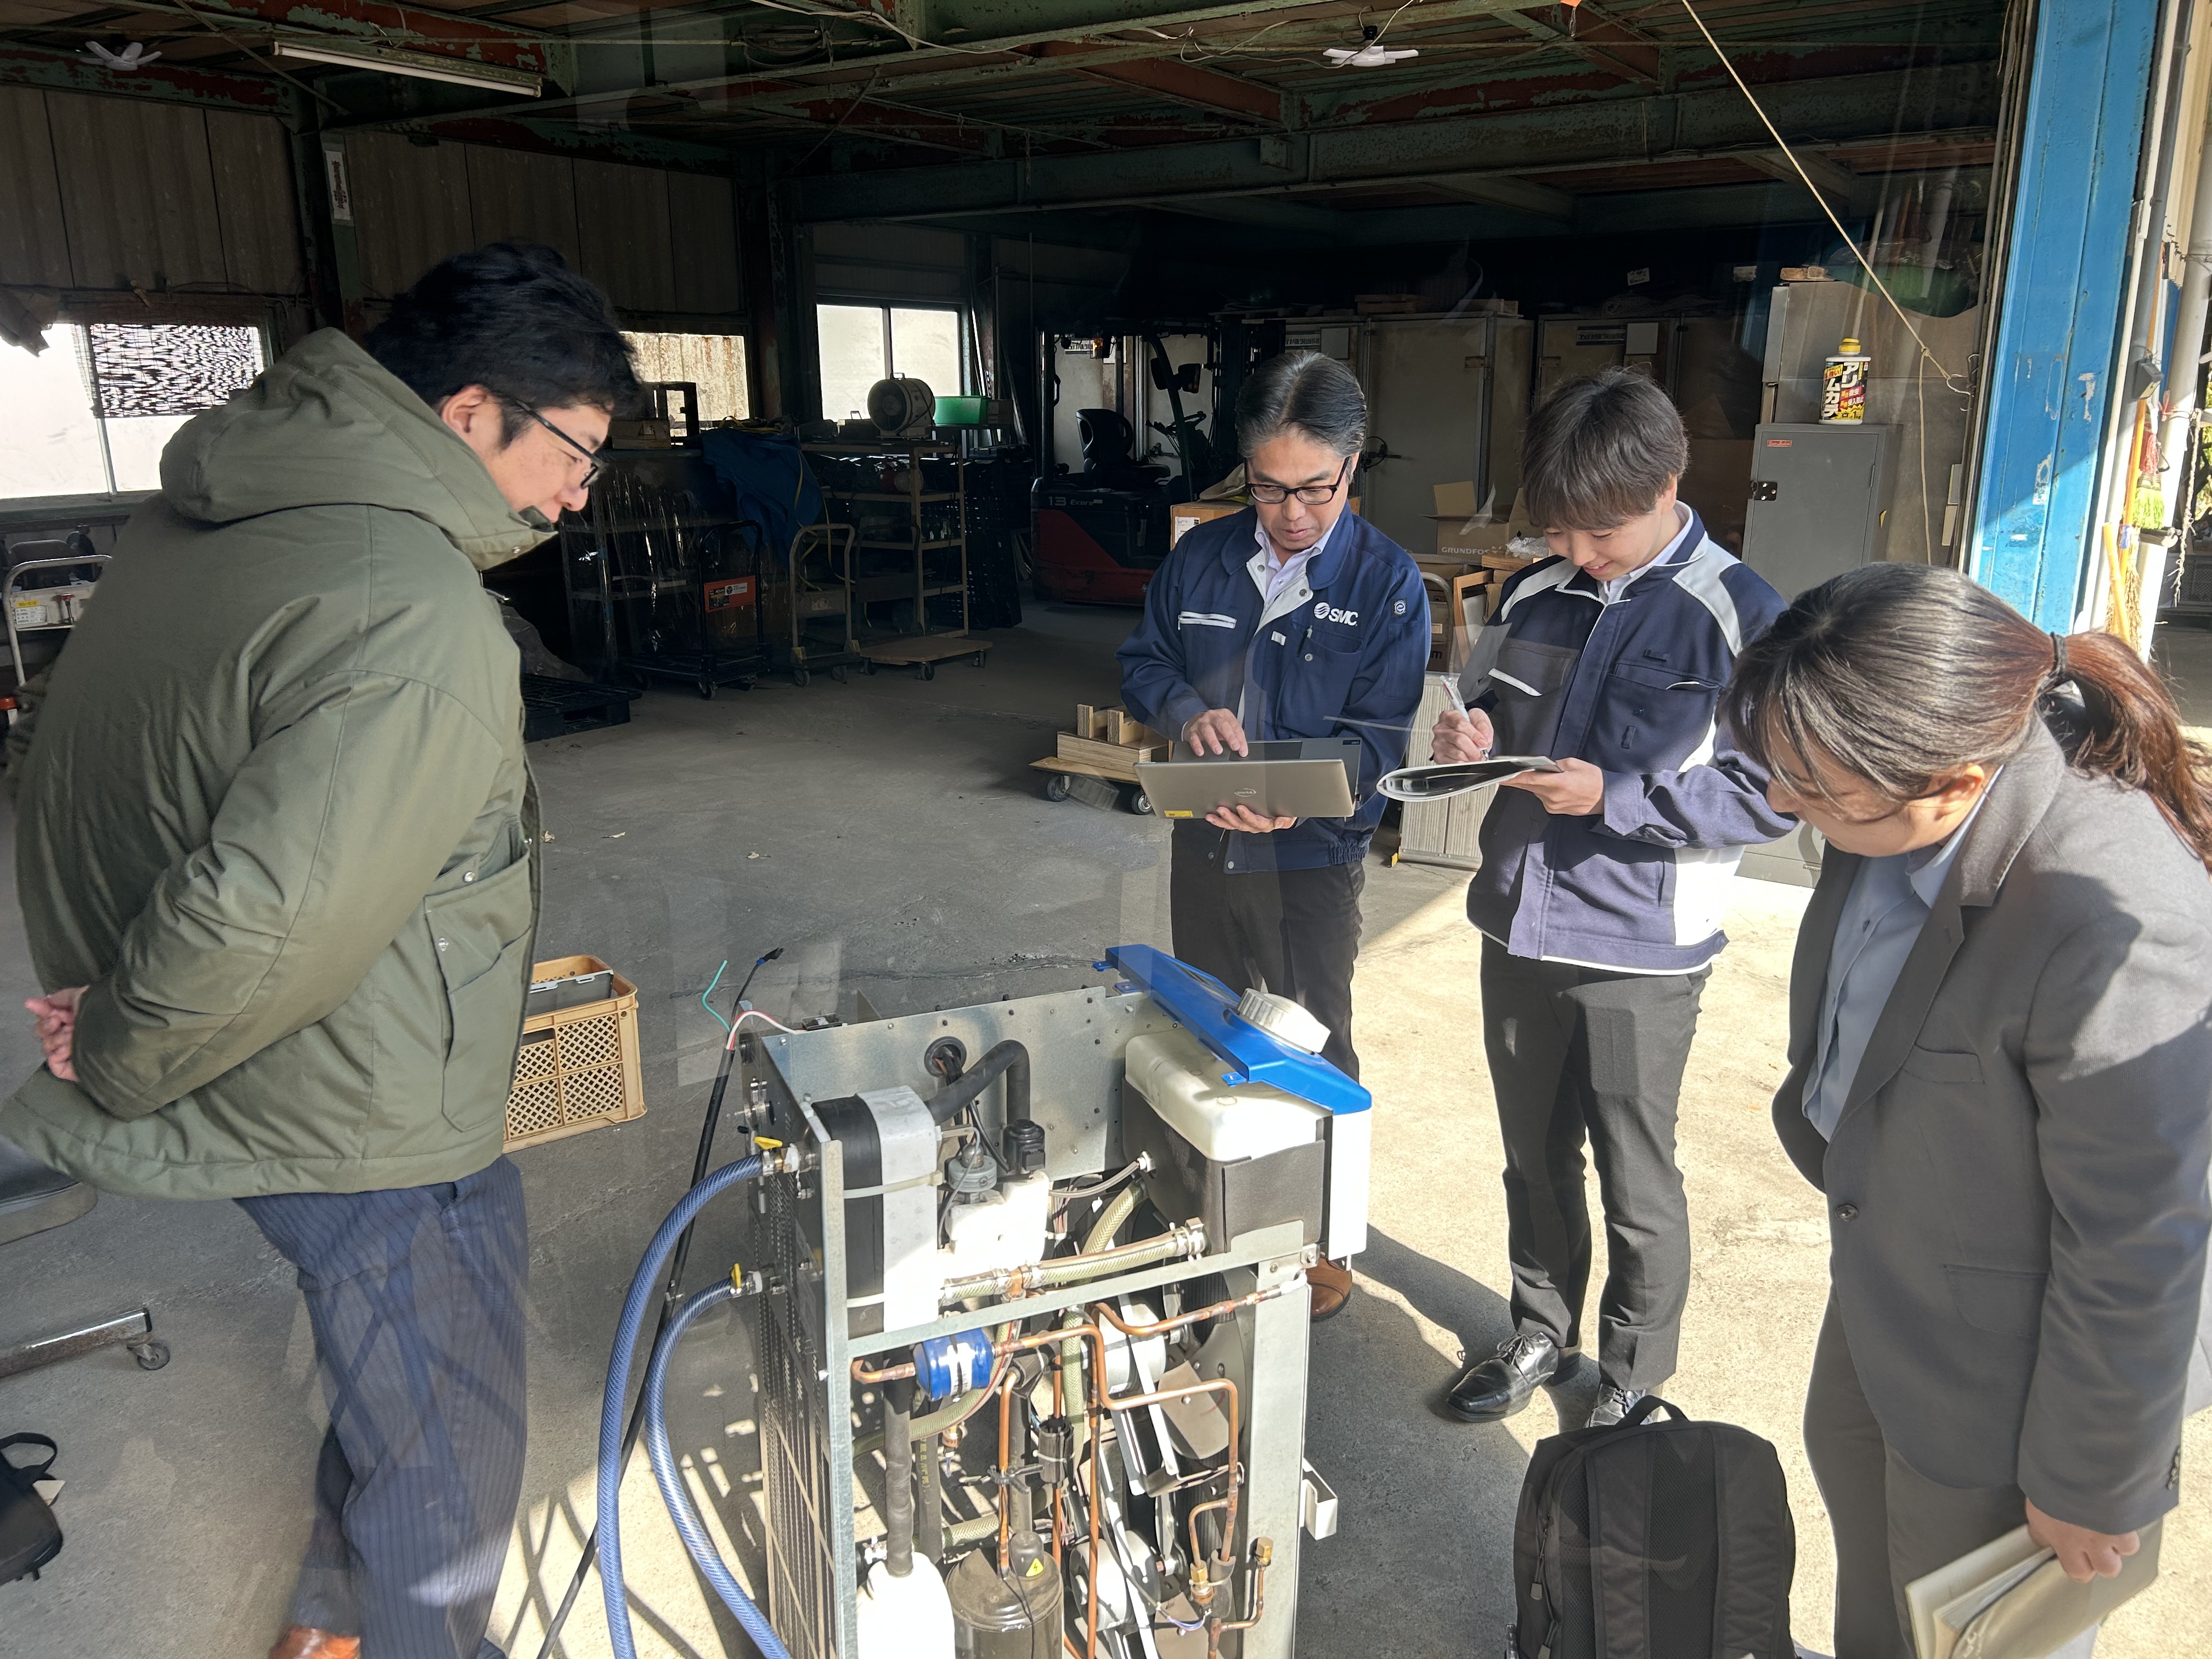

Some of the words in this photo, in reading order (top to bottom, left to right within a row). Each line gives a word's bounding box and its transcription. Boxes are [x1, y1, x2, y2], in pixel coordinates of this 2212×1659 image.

[1841, 362, 1860, 388] アリ
[1822, 377, 1841, 417] ムカデ
[1048, 496, 1067, 506] 13
[1328, 608, 1358, 626] SMC
